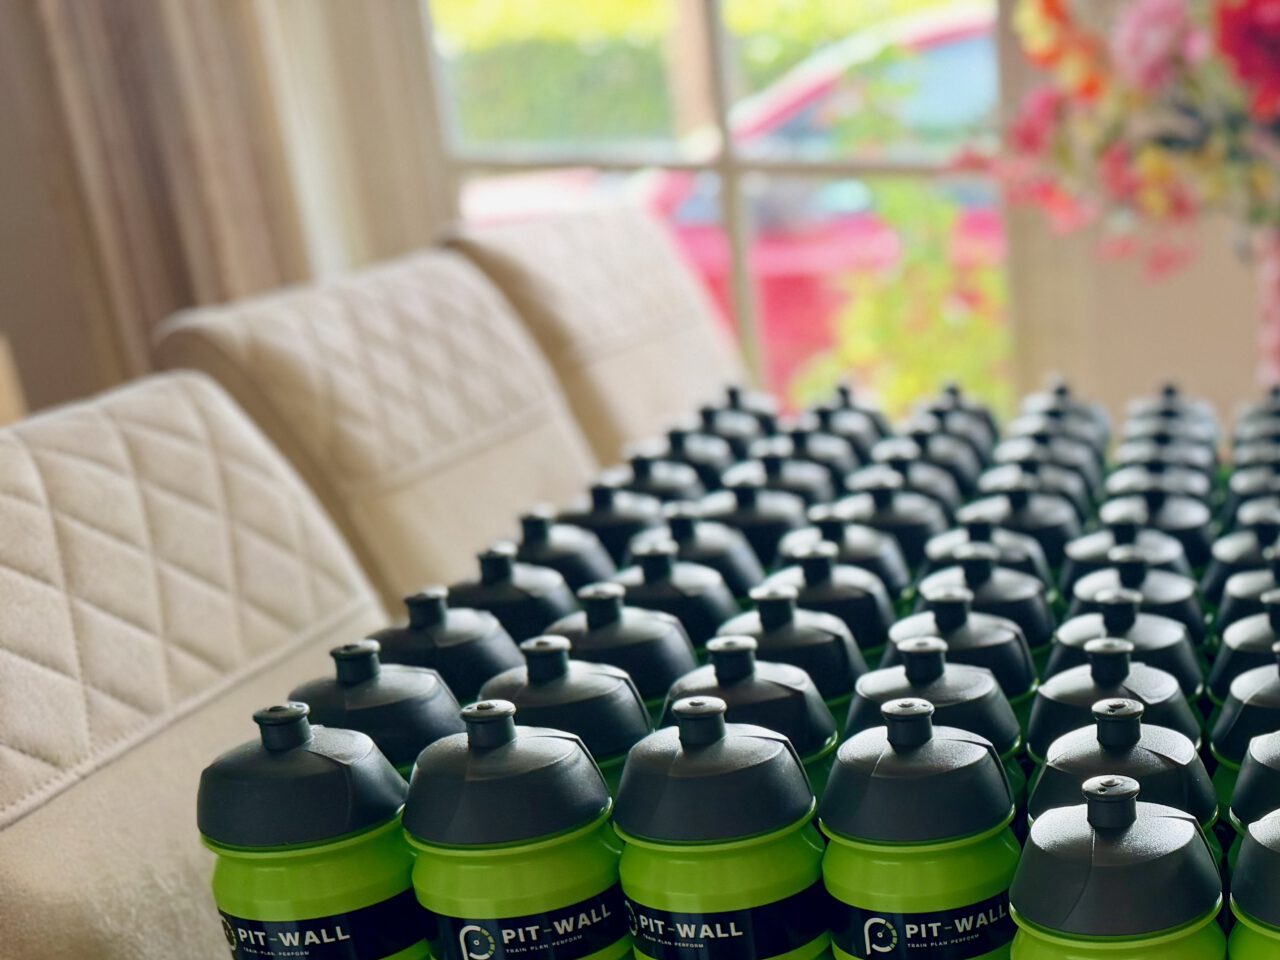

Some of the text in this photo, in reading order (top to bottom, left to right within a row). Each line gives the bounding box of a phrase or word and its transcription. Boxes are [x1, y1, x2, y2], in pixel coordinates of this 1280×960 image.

[237, 925, 351, 948] PIT-WALL
[502, 903, 612, 944] PIT-WALL
[639, 914, 743, 938] PIT-WALL
[905, 904, 1007, 940] PIT-WALL
